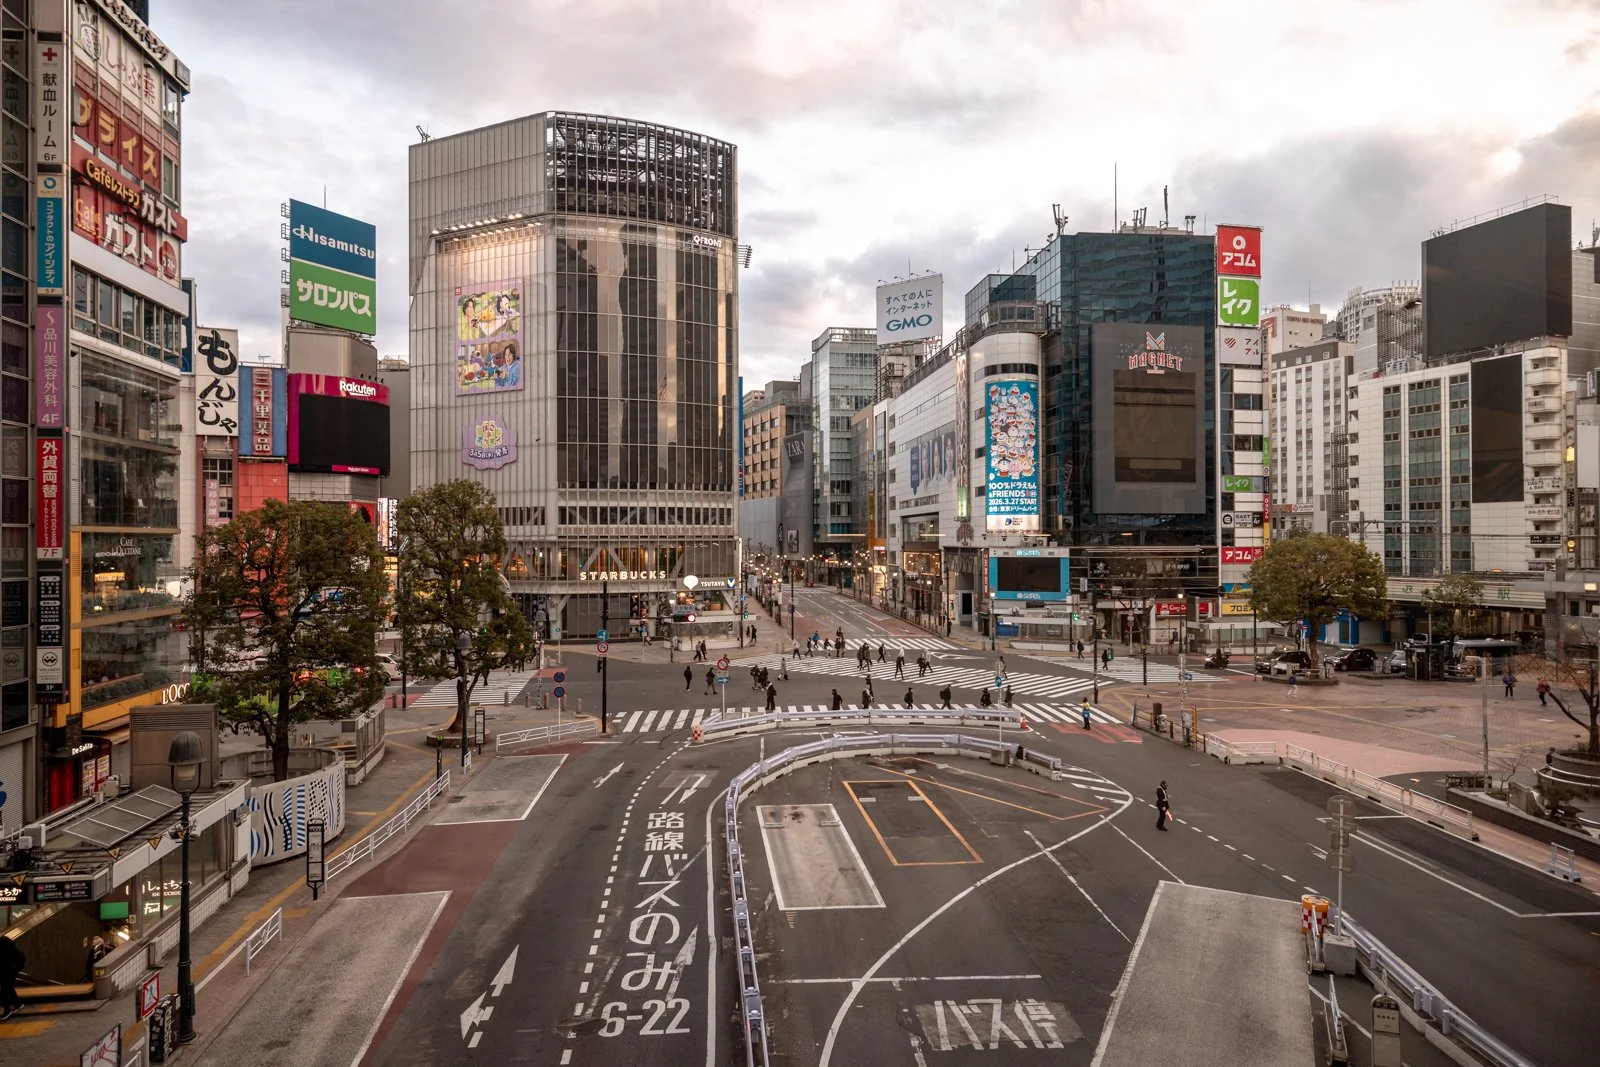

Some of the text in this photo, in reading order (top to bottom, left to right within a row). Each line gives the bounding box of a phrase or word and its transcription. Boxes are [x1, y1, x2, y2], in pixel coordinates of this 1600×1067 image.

[42, 73, 57, 148] 献血ルーム
[44, 153, 56, 161] 6F
[141, 192, 178, 235] ガスト
[104, 213, 153, 267] ガスト
[293, 224, 375, 259] Hisamitsu
[1222, 252, 1257, 268] アコム
[296, 278, 372, 317] サロンパス
[886, 289, 932, 305] すべての人に
[886, 300, 932, 315] インターネット
[886, 314, 932, 331] GMO
[43, 328, 58, 407] 品川美容外科
[1128, 351, 1183, 372] MAGNET
[198, 329, 238, 433] もんじゃ
[339, 380, 377, 397] Rakuten
[42, 413, 59, 423] 4F
[255, 370, 271, 452] 三千里薬品
[786, 440, 805, 457] ZARA
[42, 440, 58, 498] 外貨両替
[1225, 478, 1249, 489] レイク
[42, 549, 58, 557] 7F
[1225, 551, 1252, 560] アコム
[579, 570, 667, 581] STARBUCKS
[620, 811, 689, 992] 路線バスのみ
[597, 997, 691, 1038] 6-22
[933, 998, 1065, 1051] バス停
